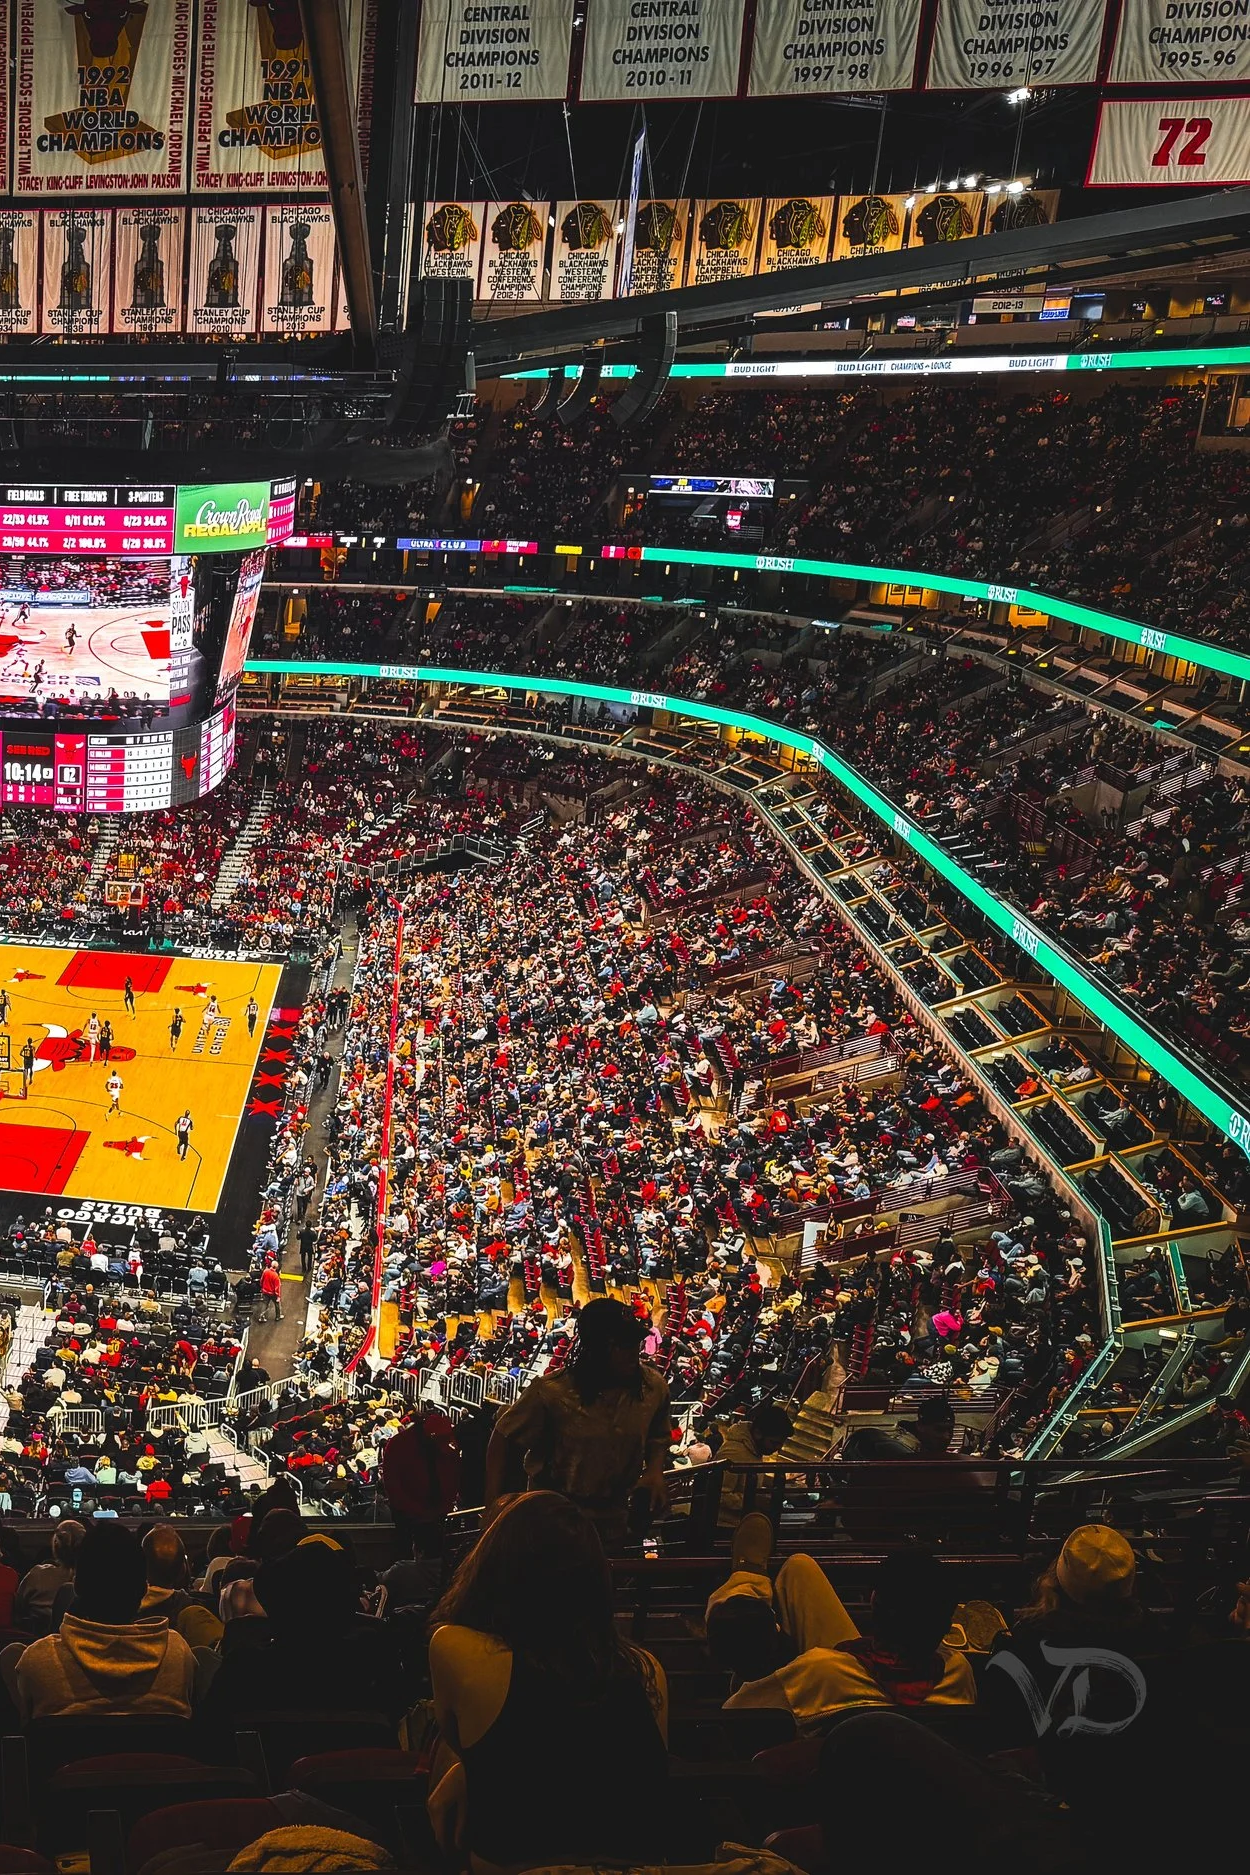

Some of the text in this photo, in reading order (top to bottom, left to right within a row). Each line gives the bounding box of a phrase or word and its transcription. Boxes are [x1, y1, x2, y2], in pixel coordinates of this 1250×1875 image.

[464, 5, 529, 22] CENTRAL
[630, 0, 699, 18] CENTRAL
[1166, 0, 1248, 19] DIVISION
[798, 16, 874, 37] DIVISION
[978, 10, 1058, 31] DIVISION
[460, 27, 530, 45] DIVISION
[626, 23, 700, 41] DIVISION
[783, 39, 885, 60] CHAMPIONS
[963, 33, 1069, 55] CHAMPIONS
[445, 50, 540, 68] CHAMPIONS
[612, 46, 710, 64] CHAMPIONS
[77, 65, 131, 85] 1992
[261, 58, 310, 79] 1991
[79, 87, 125, 107] NBA
[263, 81, 310, 101] NBA
[62, 110, 140, 131] WORLD
[36, 132, 165, 153] CHAMPIONS
[219, 126, 322, 148] CHAMPIO
[1151, 118, 1213, 167] 72
[168, 130, 183, 173] JORDAN
[18, 173, 181, 191] STACEY PAXSON
[196, 173, 224, 188] STACEY
[197, 215, 255, 223] BLACKHAWKS
[207, 207, 246, 215] CHICAGO
[271, 215, 330, 223] BLACKHAWKS
[282, 207, 321, 215] CHICAGO
[50, 219, 105, 227] BLACKHAWKS
[489, 259, 538, 267] BLACKHAWKS
[498, 252, 530, 260] CHICAGO
[767, 256, 820, 265] BLACKHAWKS
[487, 275, 536, 283] CONFERENCE
[557, 275, 607, 283] CONFERENCE
[565, 267, 601, 275] WESTERN
[490, 283, 531, 291] CHAMPIONS
[560, 283, 602, 291] CHAMPIONS
[992, 301, 1024, 310] 2012-13
[734, 365, 777, 373] BUD LIGHT
[837, 363, 883, 372] BUD LIGHT
[1009, 357, 1055, 368] BUD LIGHT
[1087, 355, 1112, 367] RUSH
[7, 490, 24, 501] FIELD
[64, 490, 80, 502] FREE
[196, 501, 235, 528] Crown
[184, 523, 239, 536] REGAL
[241, 518, 267, 533] APPLE
[410, 540, 466, 549] ULTRA CLUB
[765, 557, 794, 571] RUSH
[994, 585, 1017, 601] RUSH
[171, 614, 191, 635] PASS
[1145, 631, 1165, 649] RUSH
[388, 666, 419, 678] RUSH
[640, 692, 667, 705] RUSH
[4, 762, 42, 782] 10:14
[7, 937, 90, 949] FANDUEL
[209, 1027, 228, 1055] CENTER
[80, 1201, 163, 1218] BULLS
